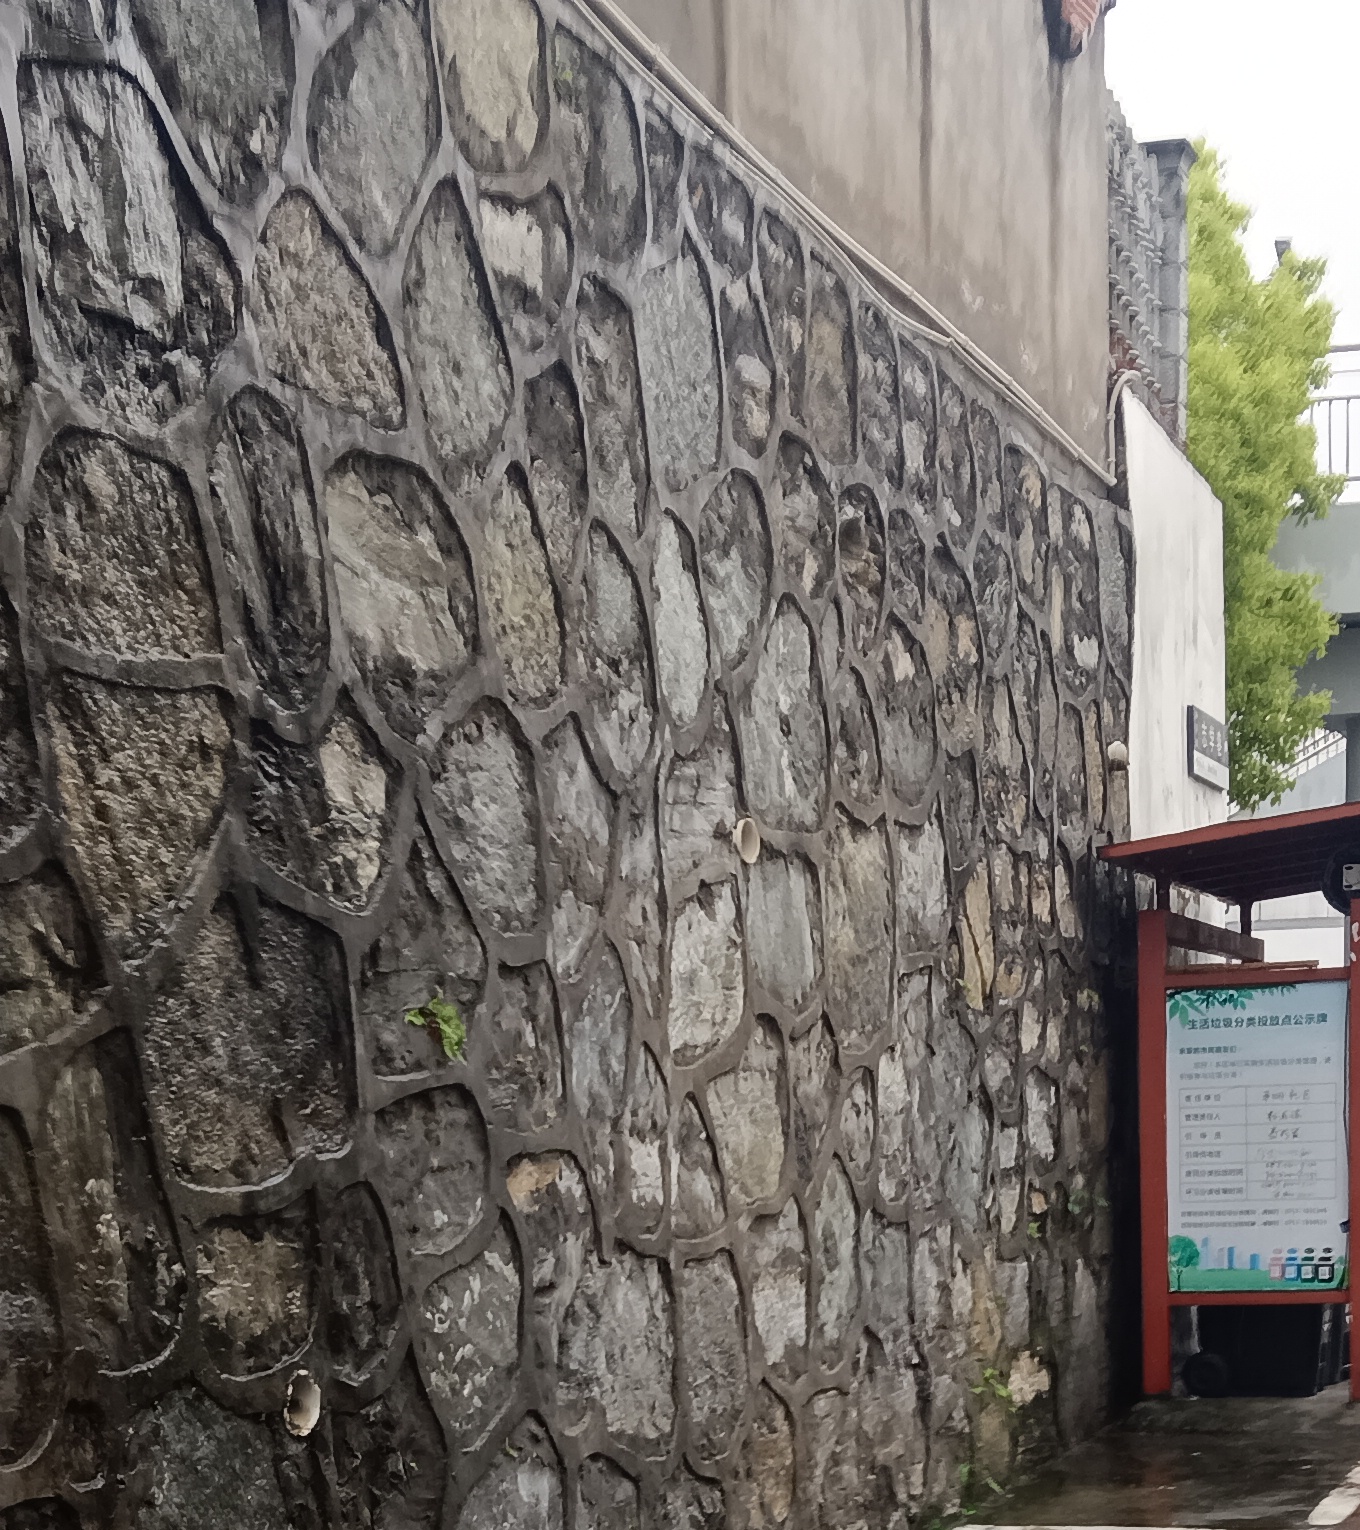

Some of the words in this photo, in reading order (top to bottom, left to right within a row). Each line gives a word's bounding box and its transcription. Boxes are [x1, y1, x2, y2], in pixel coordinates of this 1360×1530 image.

[1187, 1012, 1328, 1030] 生活垃圾分类投放点公示牌
